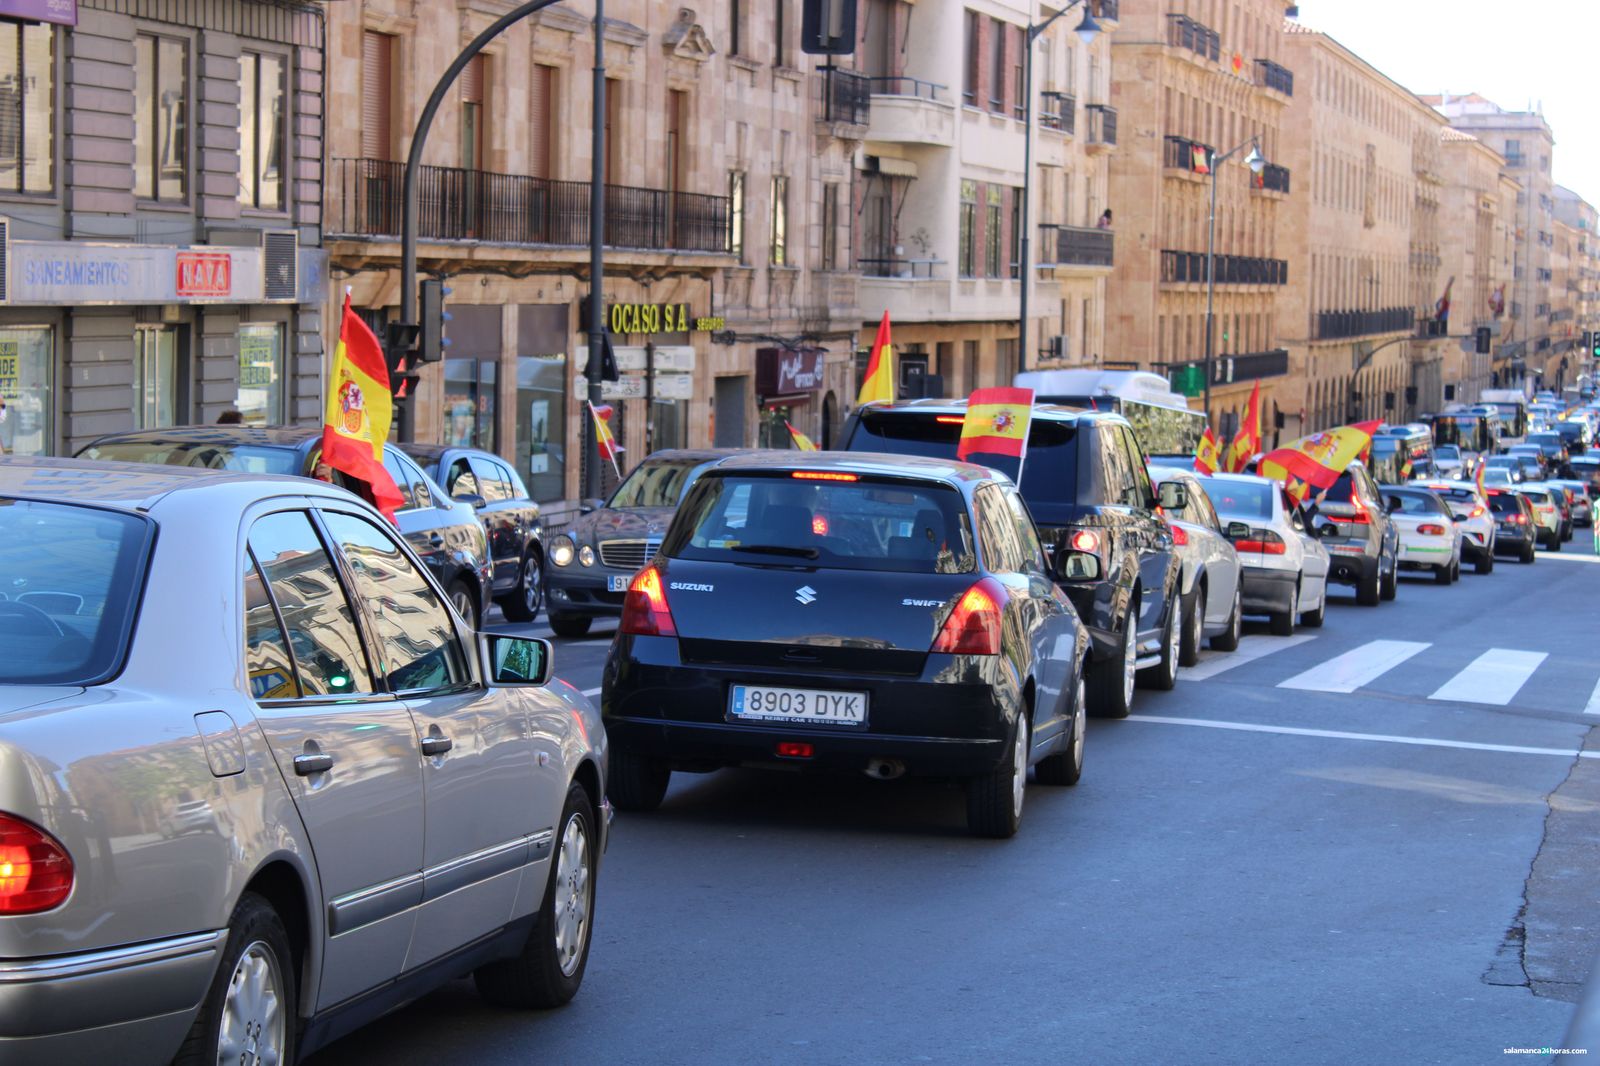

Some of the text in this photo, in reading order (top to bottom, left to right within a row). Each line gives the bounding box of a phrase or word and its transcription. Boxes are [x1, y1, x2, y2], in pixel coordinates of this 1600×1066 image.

[25, 261, 226, 290] SANEAMIENTOS NAVA
[670, 582, 714, 592] SUZUKI
[902, 598, 946, 608] SWIFT
[750, 690, 858, 718] 8903 DYK
